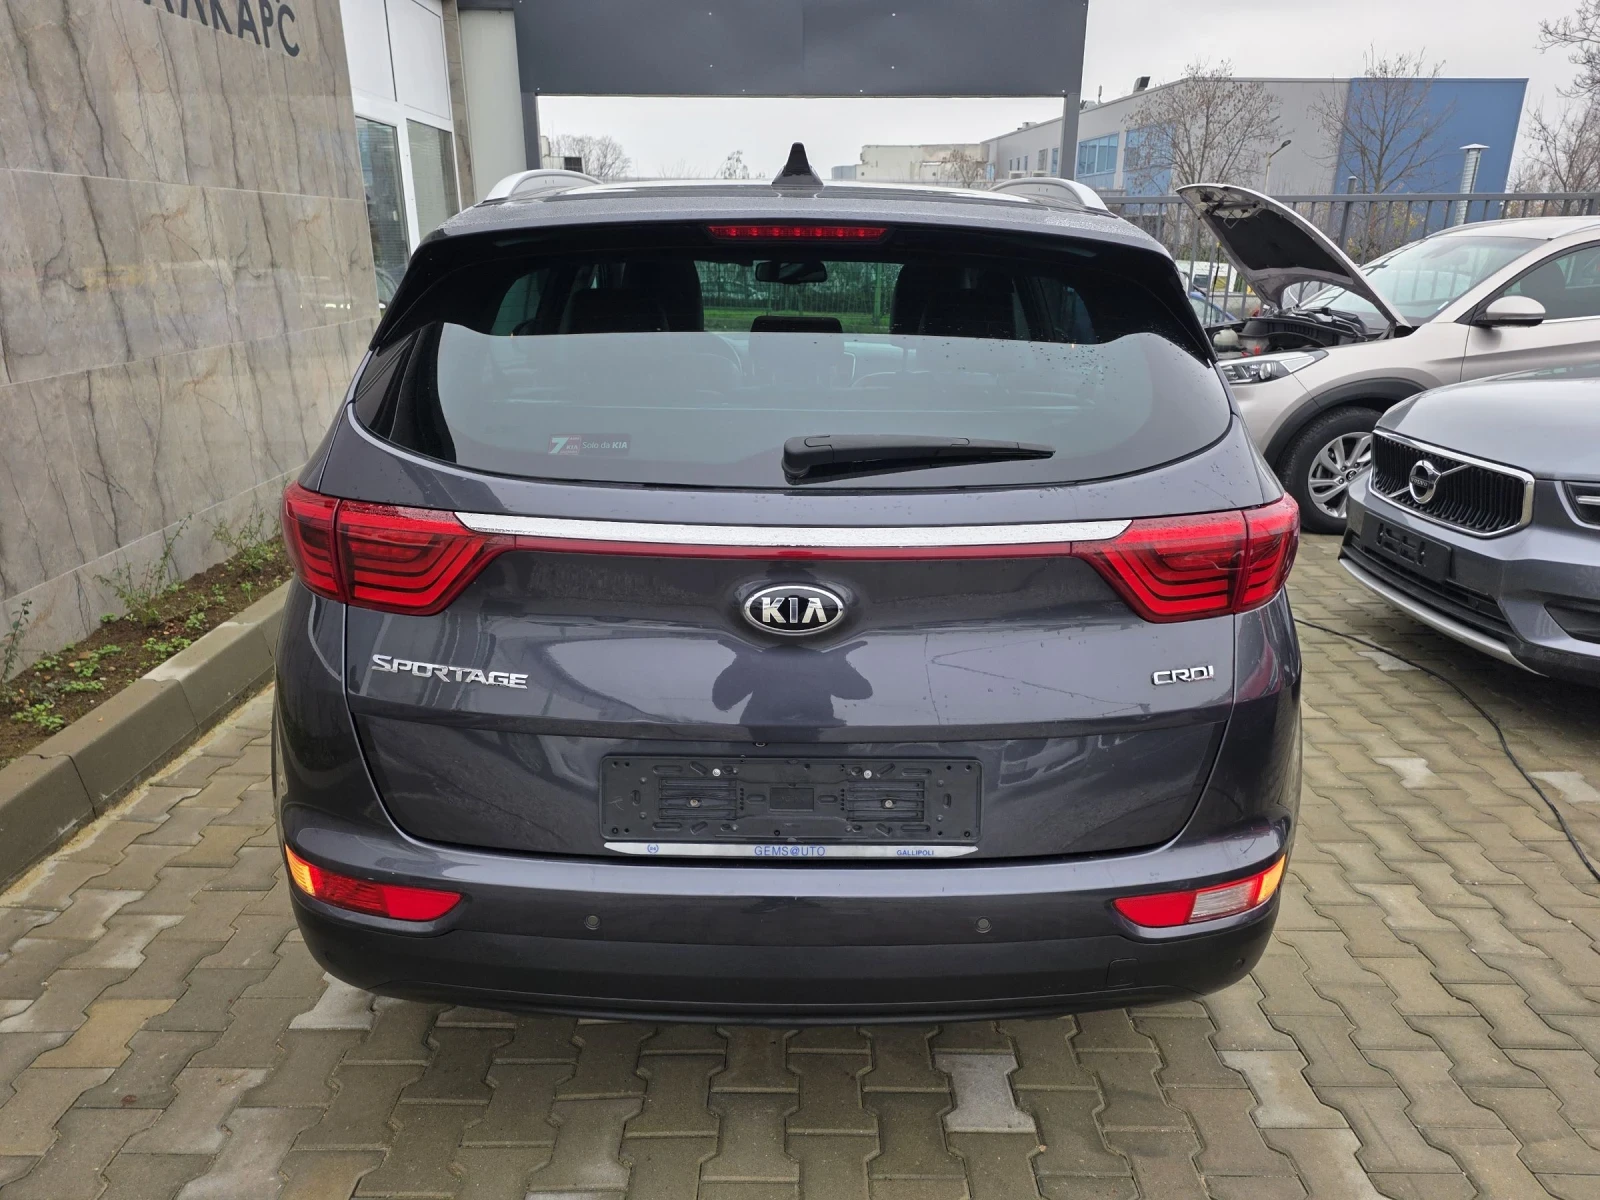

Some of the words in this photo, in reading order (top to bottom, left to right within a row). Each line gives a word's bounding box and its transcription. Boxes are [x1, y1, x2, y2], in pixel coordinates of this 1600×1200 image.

[582, 441, 599, 449] Solo
[600, 441, 610, 449] da
[612, 441, 628, 449] KIA
[1410, 476, 1428, 487] VOLVO
[761, 597, 828, 624] KIA
[371, 654, 529, 690] SPORTAGE
[754, 845, 826, 856] GEMS@UTO
